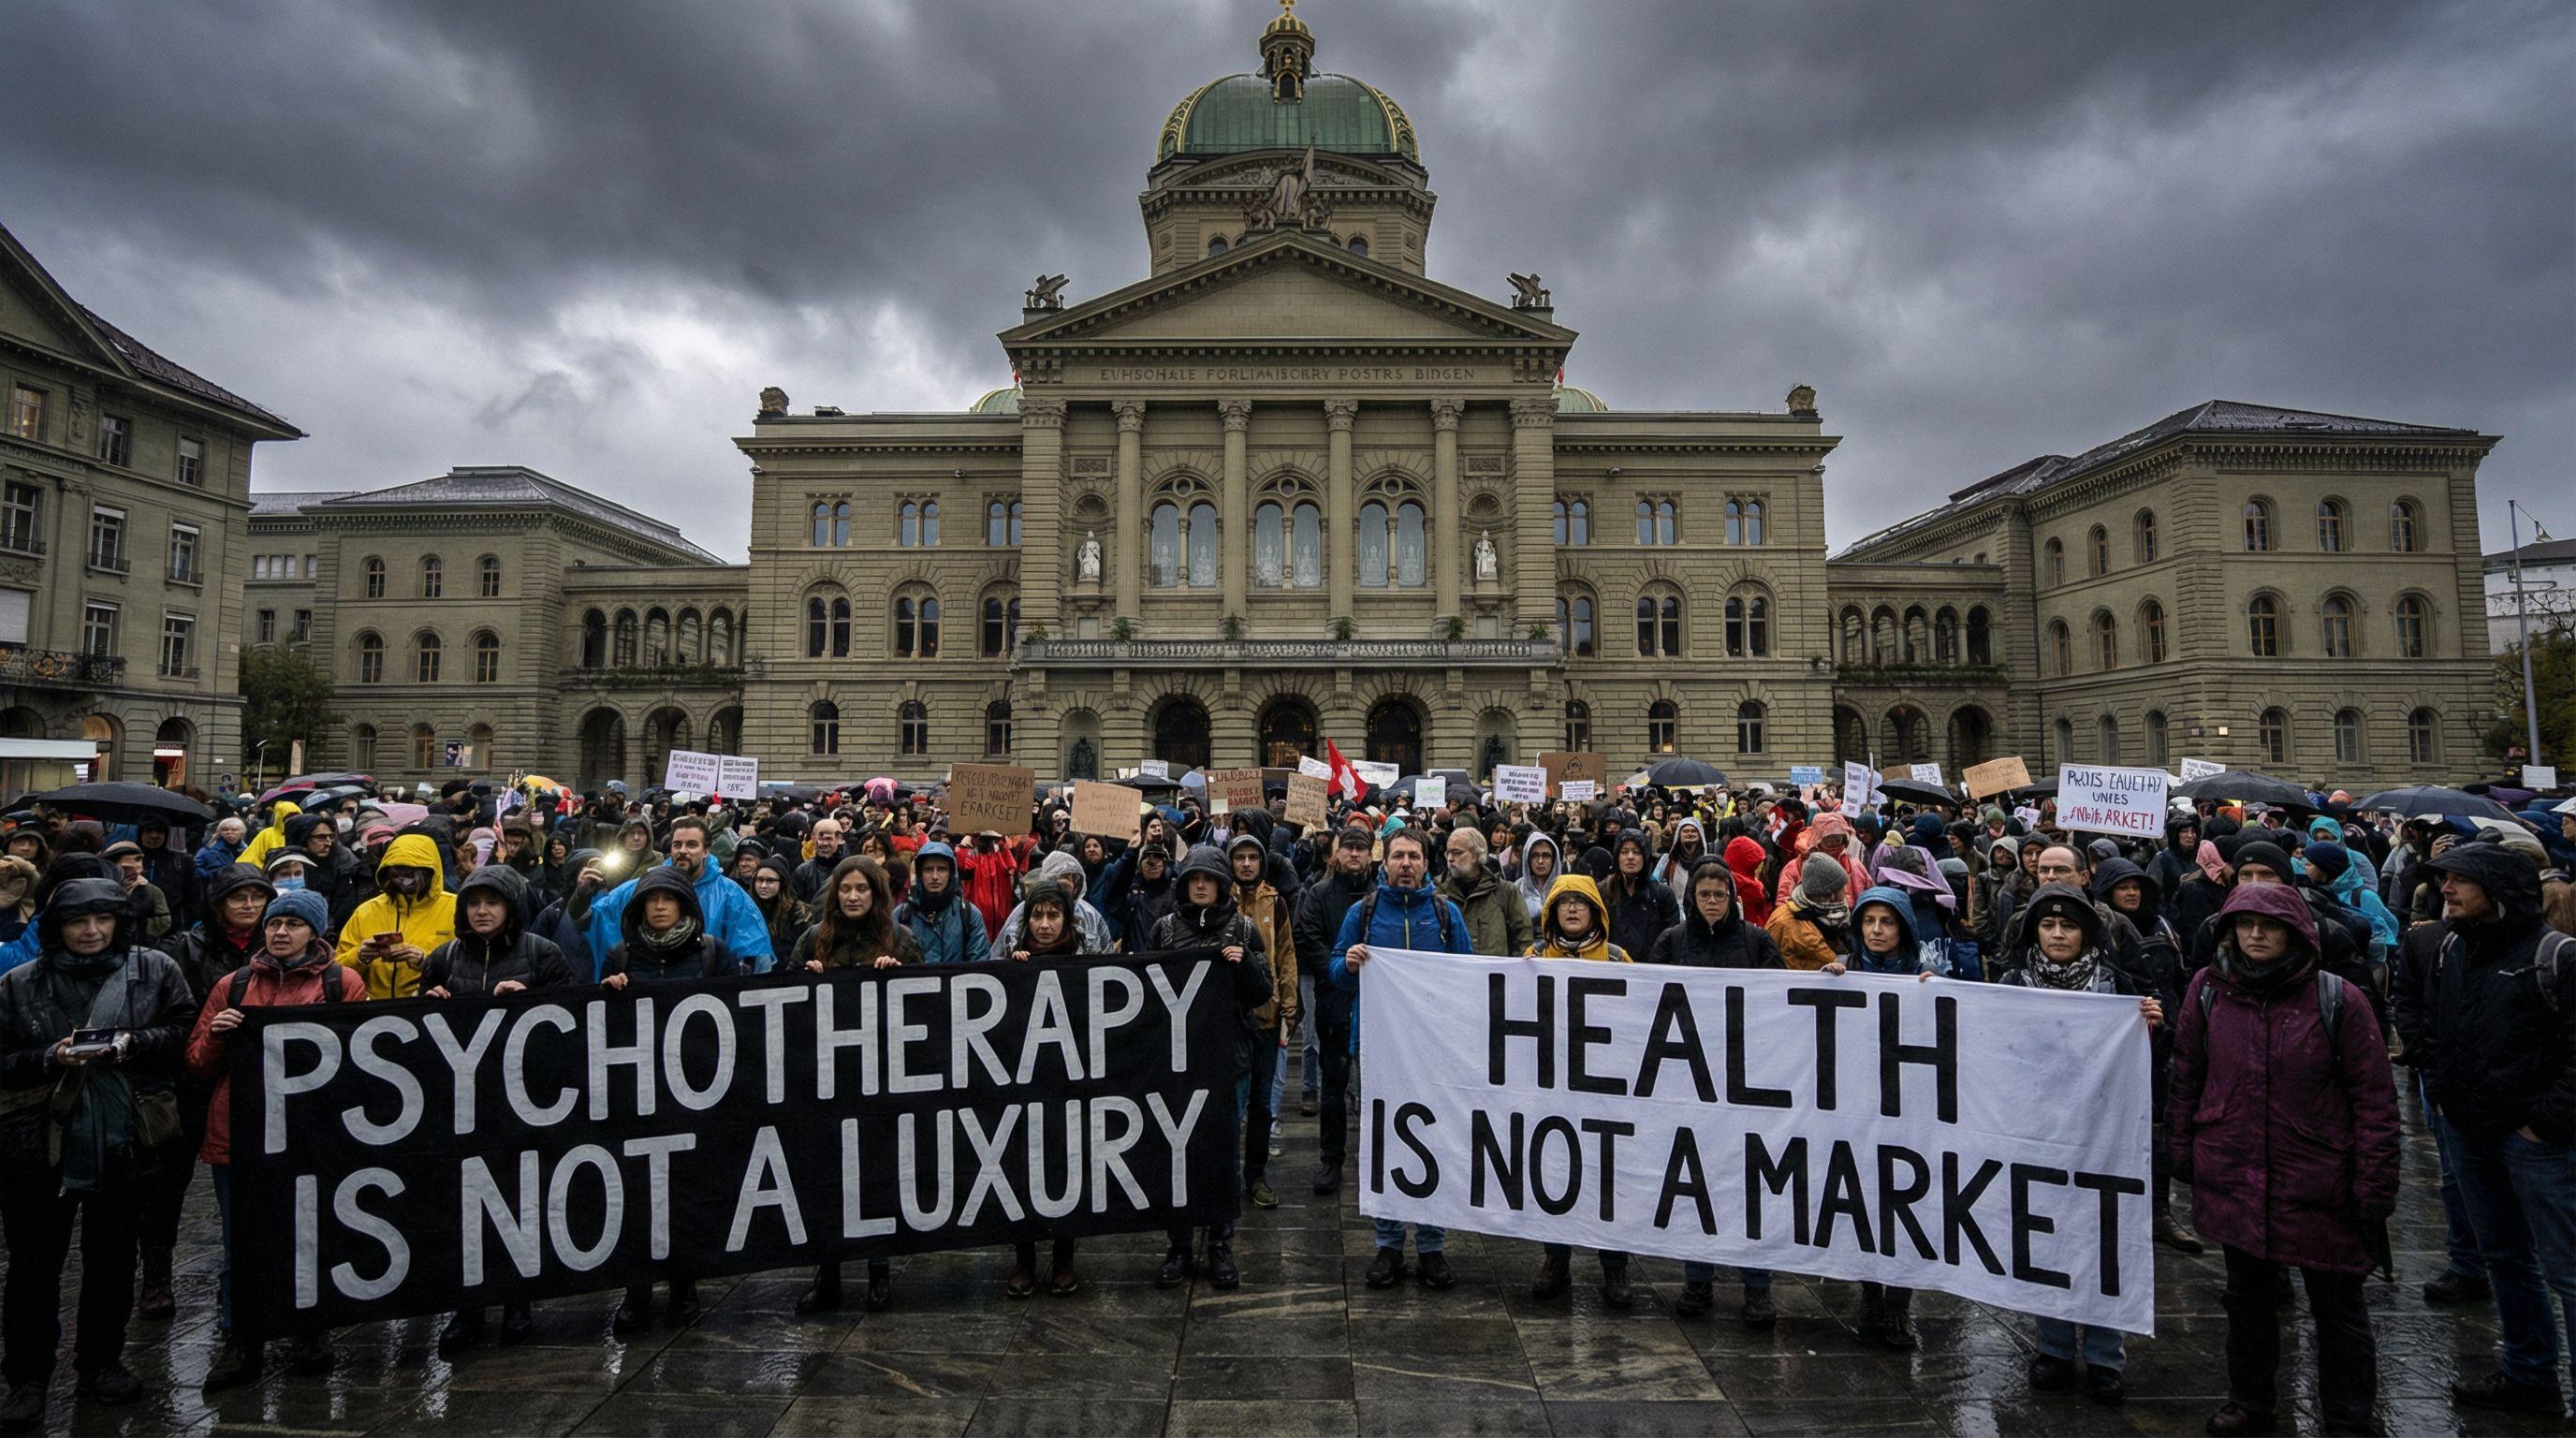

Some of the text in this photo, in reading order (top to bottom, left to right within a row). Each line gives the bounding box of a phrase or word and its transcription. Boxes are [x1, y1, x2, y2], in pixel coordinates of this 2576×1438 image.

[263, 961, 1210, 1153] PSYCHOTHERAPY
[1487, 973, 1957, 1123] HEALTH
[294, 1089, 1209, 1309] IS NOT A LUXURY
[1370, 1098, 2145, 1297] IS NOT A MARKET
